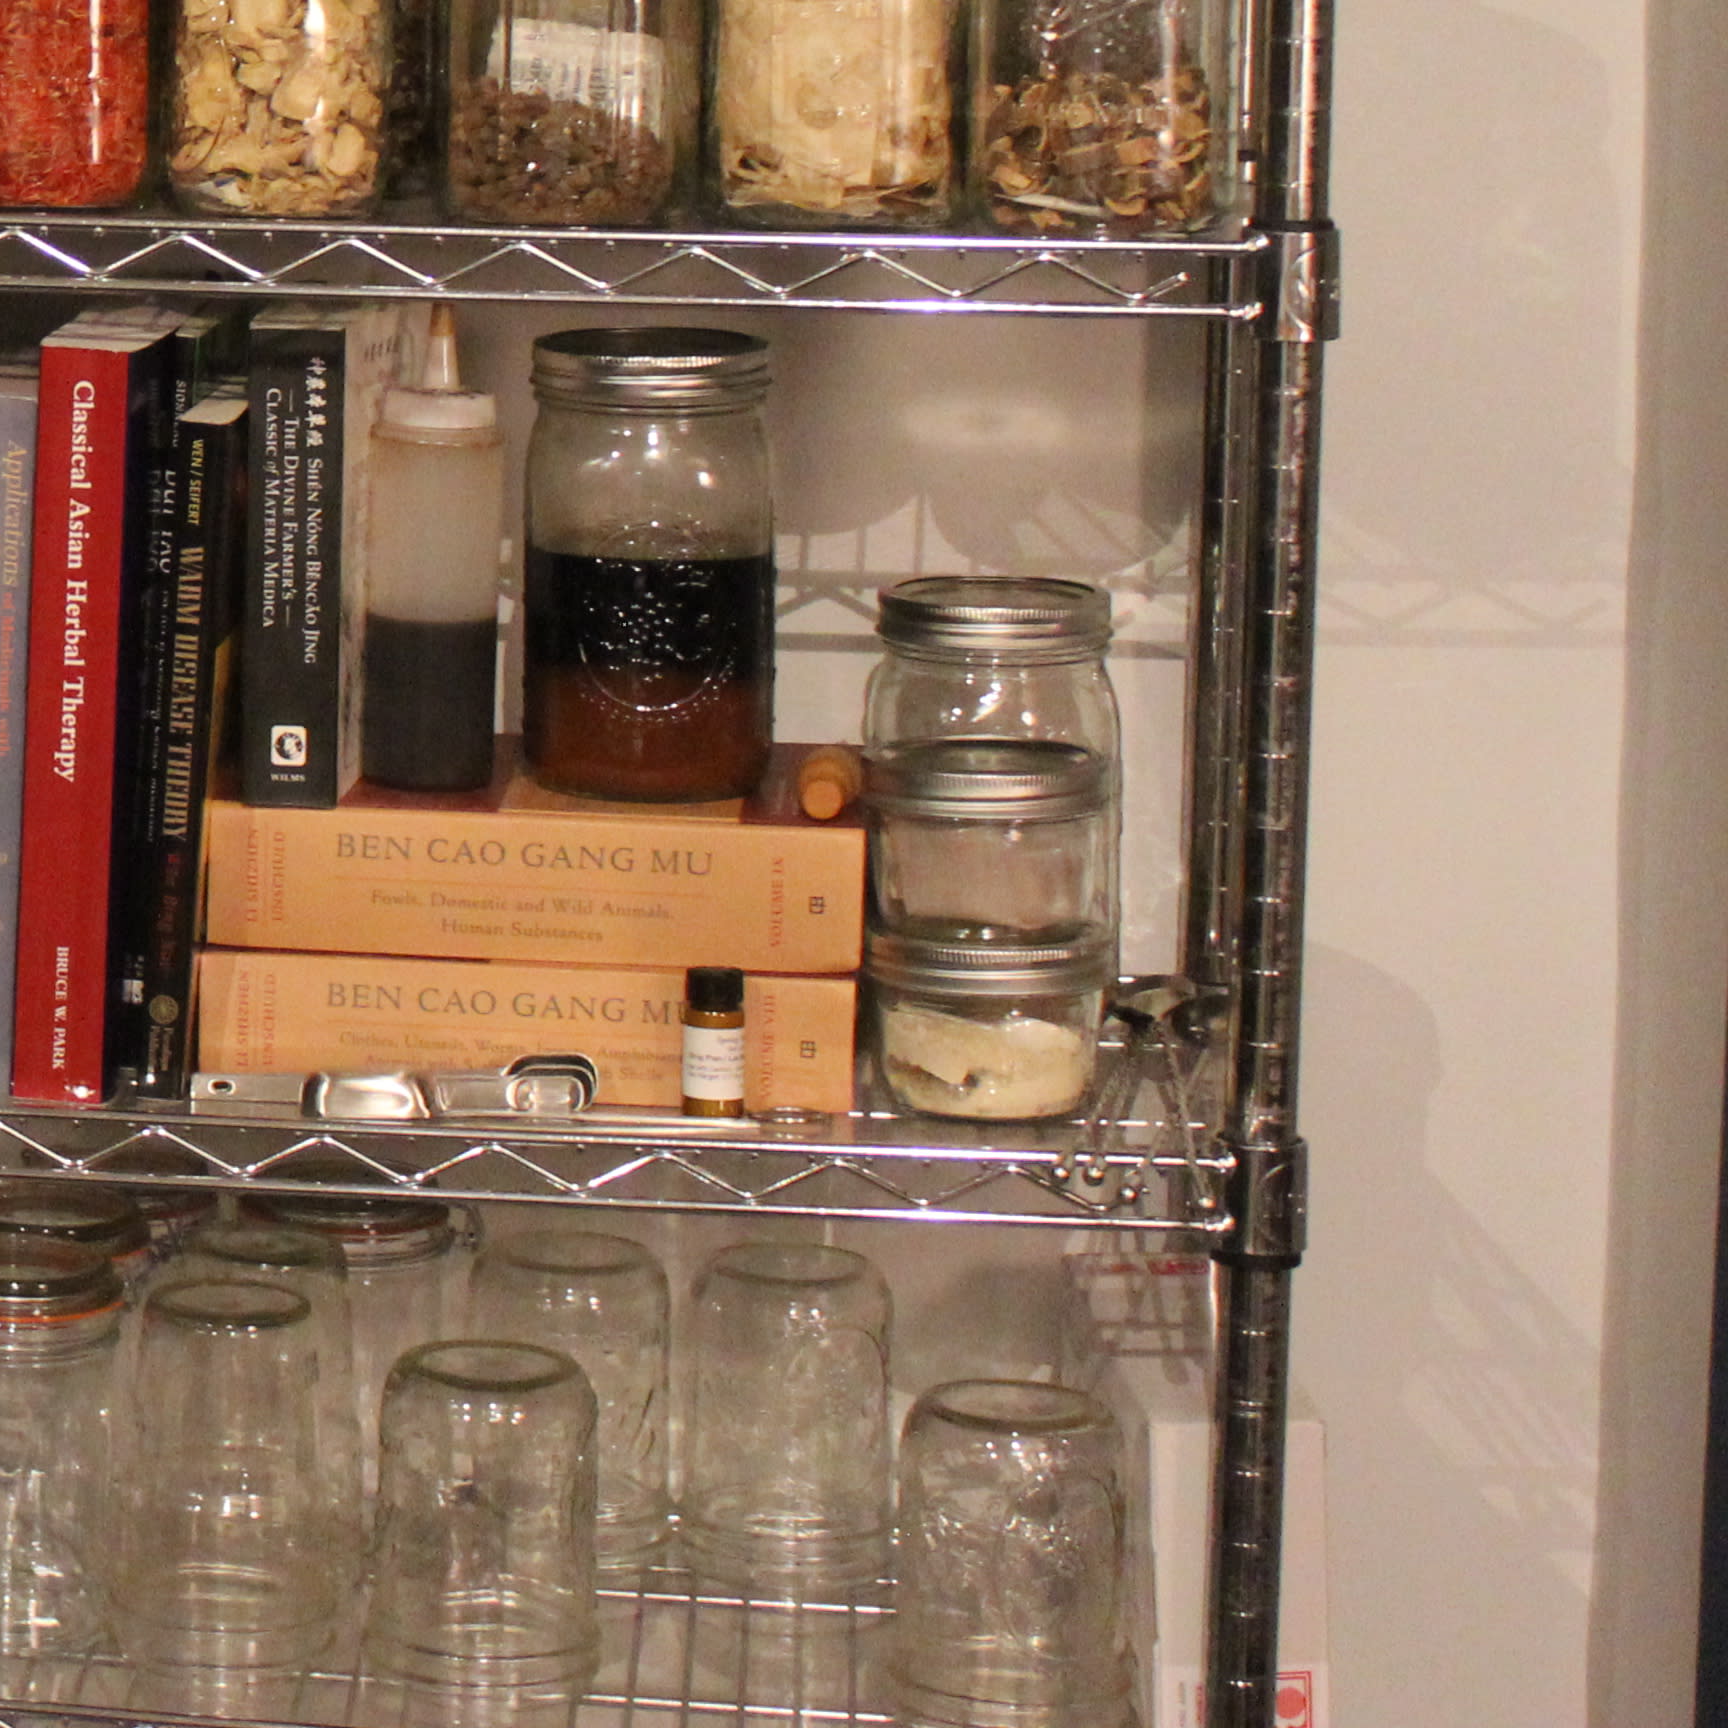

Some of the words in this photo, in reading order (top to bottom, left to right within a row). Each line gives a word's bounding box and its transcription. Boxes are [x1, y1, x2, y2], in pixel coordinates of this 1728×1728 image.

[70, 378, 97, 490] Classical
[190, 438, 204, 468] WEN
[265, 386, 283, 458] CLASSIC
[283, 416, 300, 452] THE
[186, 478, 203, 526] SEIFERT
[265, 459, 281, 476] of
[282, 455, 300, 517] DIVINE
[0, 439, 28, 588] Applications
[66, 497, 92, 569] Asian
[263, 477, 282, 557] MATERIA
[173, 546, 205, 626] WARM
[262, 561, 280, 629] MEDICA
[281, 521, 299, 602] FARMER'S
[63, 579, 89, 667] Herbal
[167, 633, 200, 735] DISEASE
[53, 676, 85, 784] Therapy
[162, 741, 193, 842] THEORY
[270, 773, 307, 783] WILMS
[336, 832, 414, 861] BEN
[425, 838, 507, 866] CAO
[520, 842, 636, 873] GANG
[649, 849, 714, 876] MU
[54, 946, 70, 1000] BRUCE
[326, 982, 402, 1010] BEN
[417, 987, 497, 1016] CAO
[511, 992, 626, 1023] GANG
[51, 1026, 67, 1071] PARK
